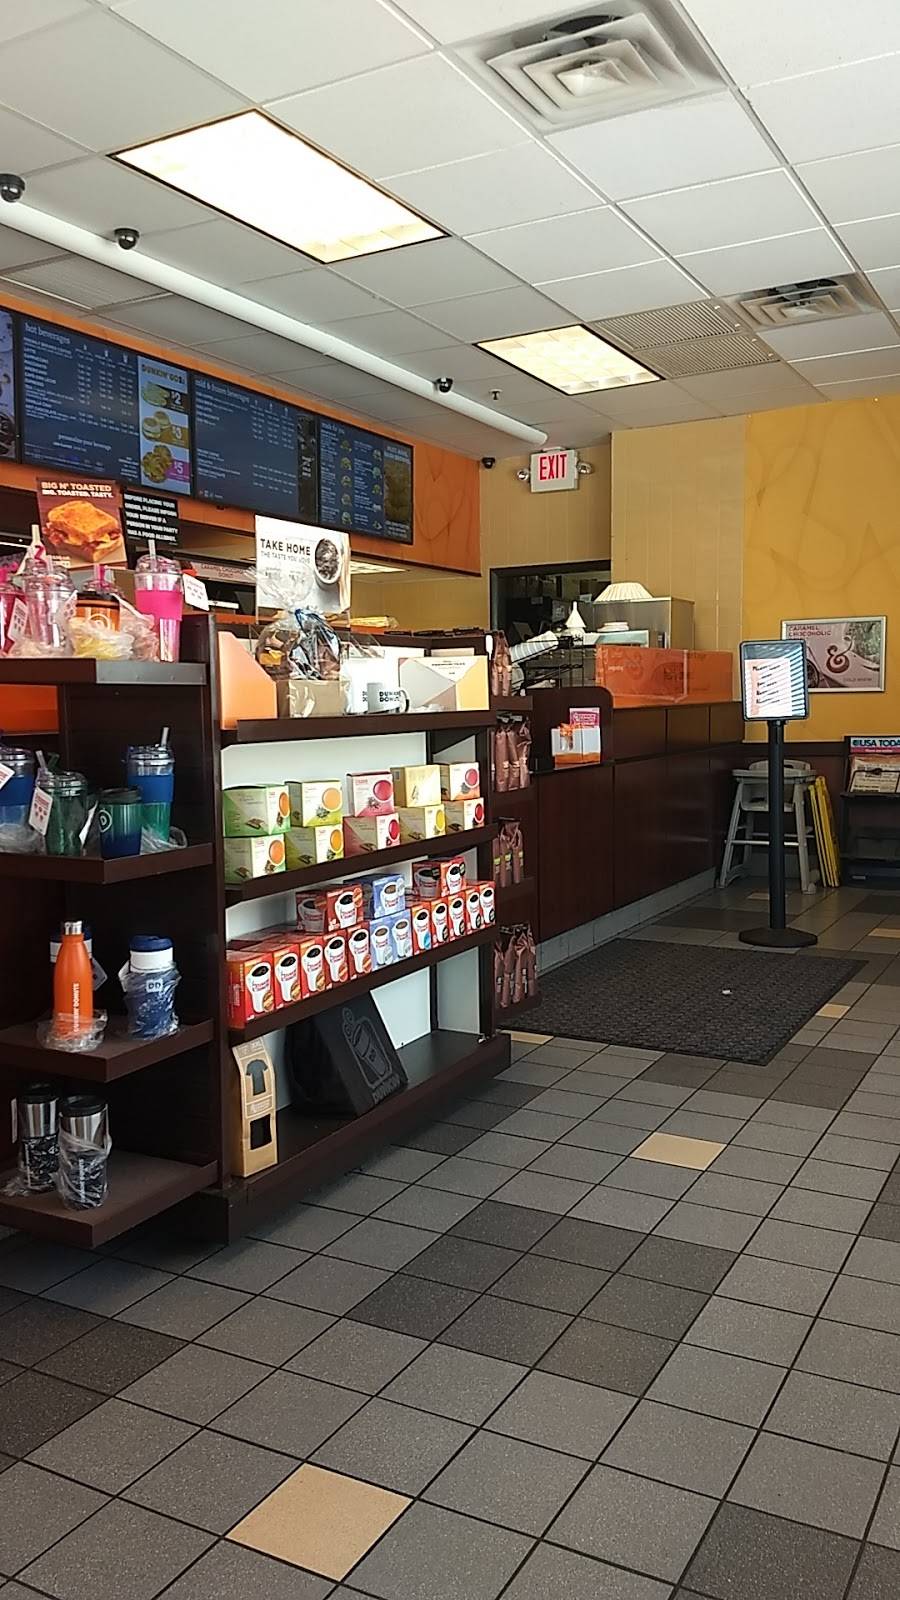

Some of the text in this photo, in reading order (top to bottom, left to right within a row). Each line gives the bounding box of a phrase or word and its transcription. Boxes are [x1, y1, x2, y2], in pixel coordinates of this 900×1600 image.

[539, 453, 567, 481] EXIT
[41, 482, 58, 490] BIG
[70, 483, 112, 492] TOASTED
[124, 493, 175, 509] BEFORE PLACING YOUR
[126, 511, 139, 519] YOUR
[139, 513, 157, 522] SERVER
[160, 509, 178, 517] INFORM
[126, 520, 146, 529] PERSON
[150, 524, 164, 532] YOUR
[163, 526, 178, 534] PARTY
[127, 528, 138, 536] HAS
[142, 531, 156, 539] FOOD
[260, 538, 311, 556] TAKE HOME
[261, 550, 270, 558] THE
[272, 552, 286, 561] TASTE
[860, 739, 877, 747] USA
